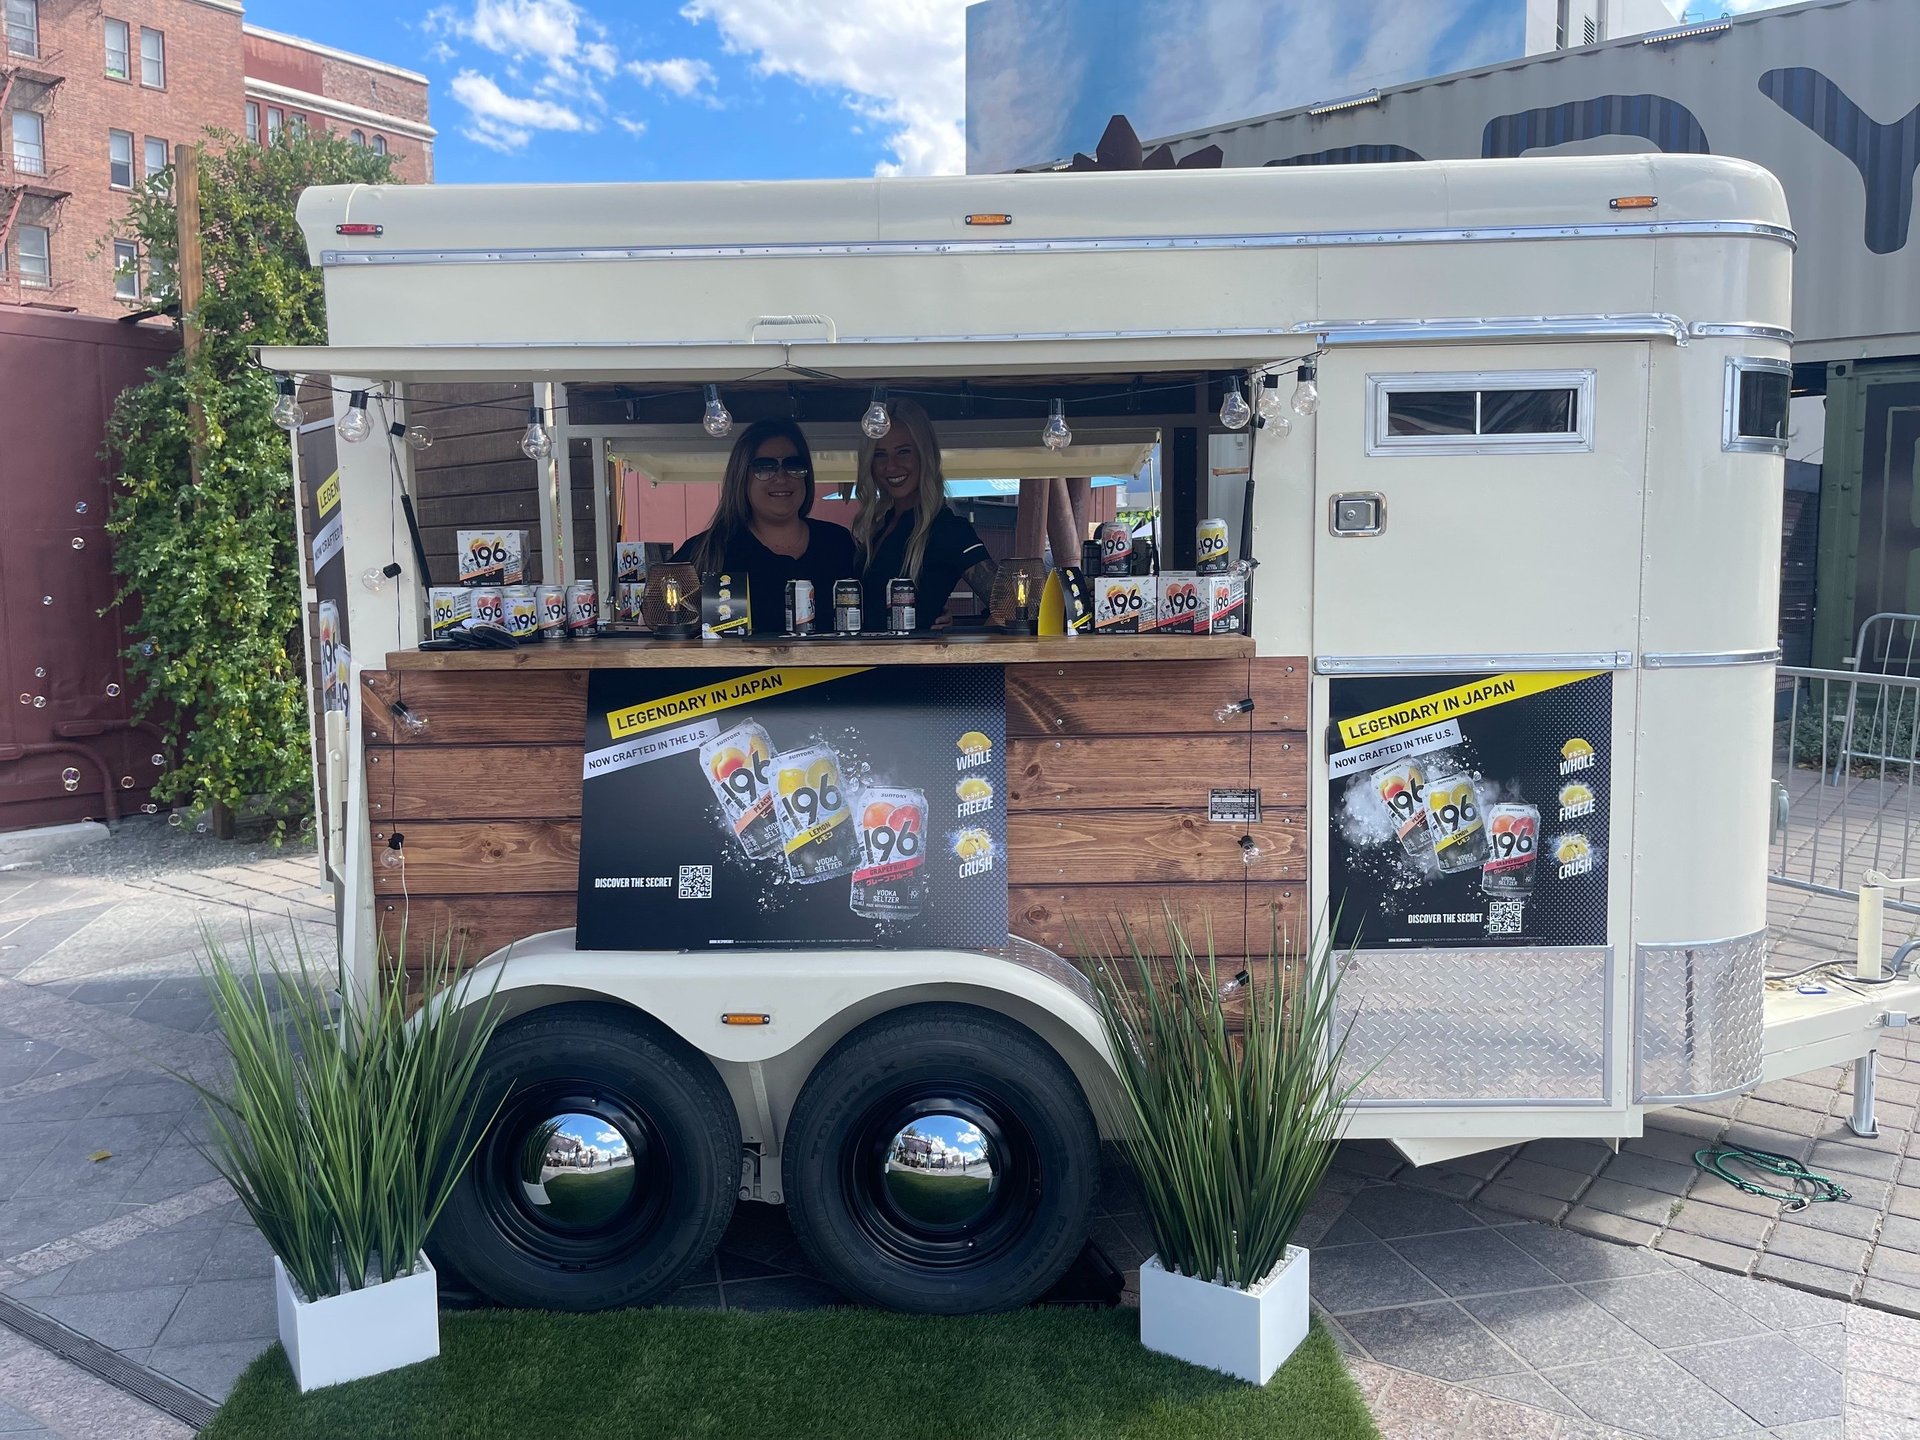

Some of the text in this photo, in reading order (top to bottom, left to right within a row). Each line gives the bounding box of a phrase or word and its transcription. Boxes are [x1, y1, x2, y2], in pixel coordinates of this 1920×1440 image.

[319, 477, 340, 509] LEGEN
[337, 682, 349, 717] -19
[617, 674, 783, 730] LEGENDARY IN JAPAN
[1348, 679, 1515, 739] LEGENDARY IN JAPAN
[716, 731, 741, 746] SUNTORY
[588, 730, 709, 770] NOW CRAFTED IN THE U.S.
[788, 750, 815, 761] SUNTORY
[1334, 729, 1454, 769] NOW CRAFTED IN THE U.S.
[956, 749, 992, 771] WHOLE
[1559, 753, 1595, 775] WHOLE
[753, 794, 772, 813] PEACH
[957, 795, 994, 818] FREEZE
[1559, 798, 1596, 822] FREEZE
[764, 821, 779, 833] VOD
[764, 829, 781, 840] SELT
[808, 821, 831, 838] LEMON
[1452, 829, 1469, 841] LEMON
[814, 861, 843, 874] SELTZER
[816, 855, 839, 866] VODKA
[870, 862, 907, 875] GRAPEFRUIT
[959, 855, 993, 879] CRUSH
[1558, 857, 1592, 880] CRUSH
[594, 877, 673, 888] DISCOVER THE SECRET
[872, 896, 900, 904] SELTZER
[876, 889, 897, 897] VODKA
[1407, 913, 1483, 924] DISCOVER THE SECRET
